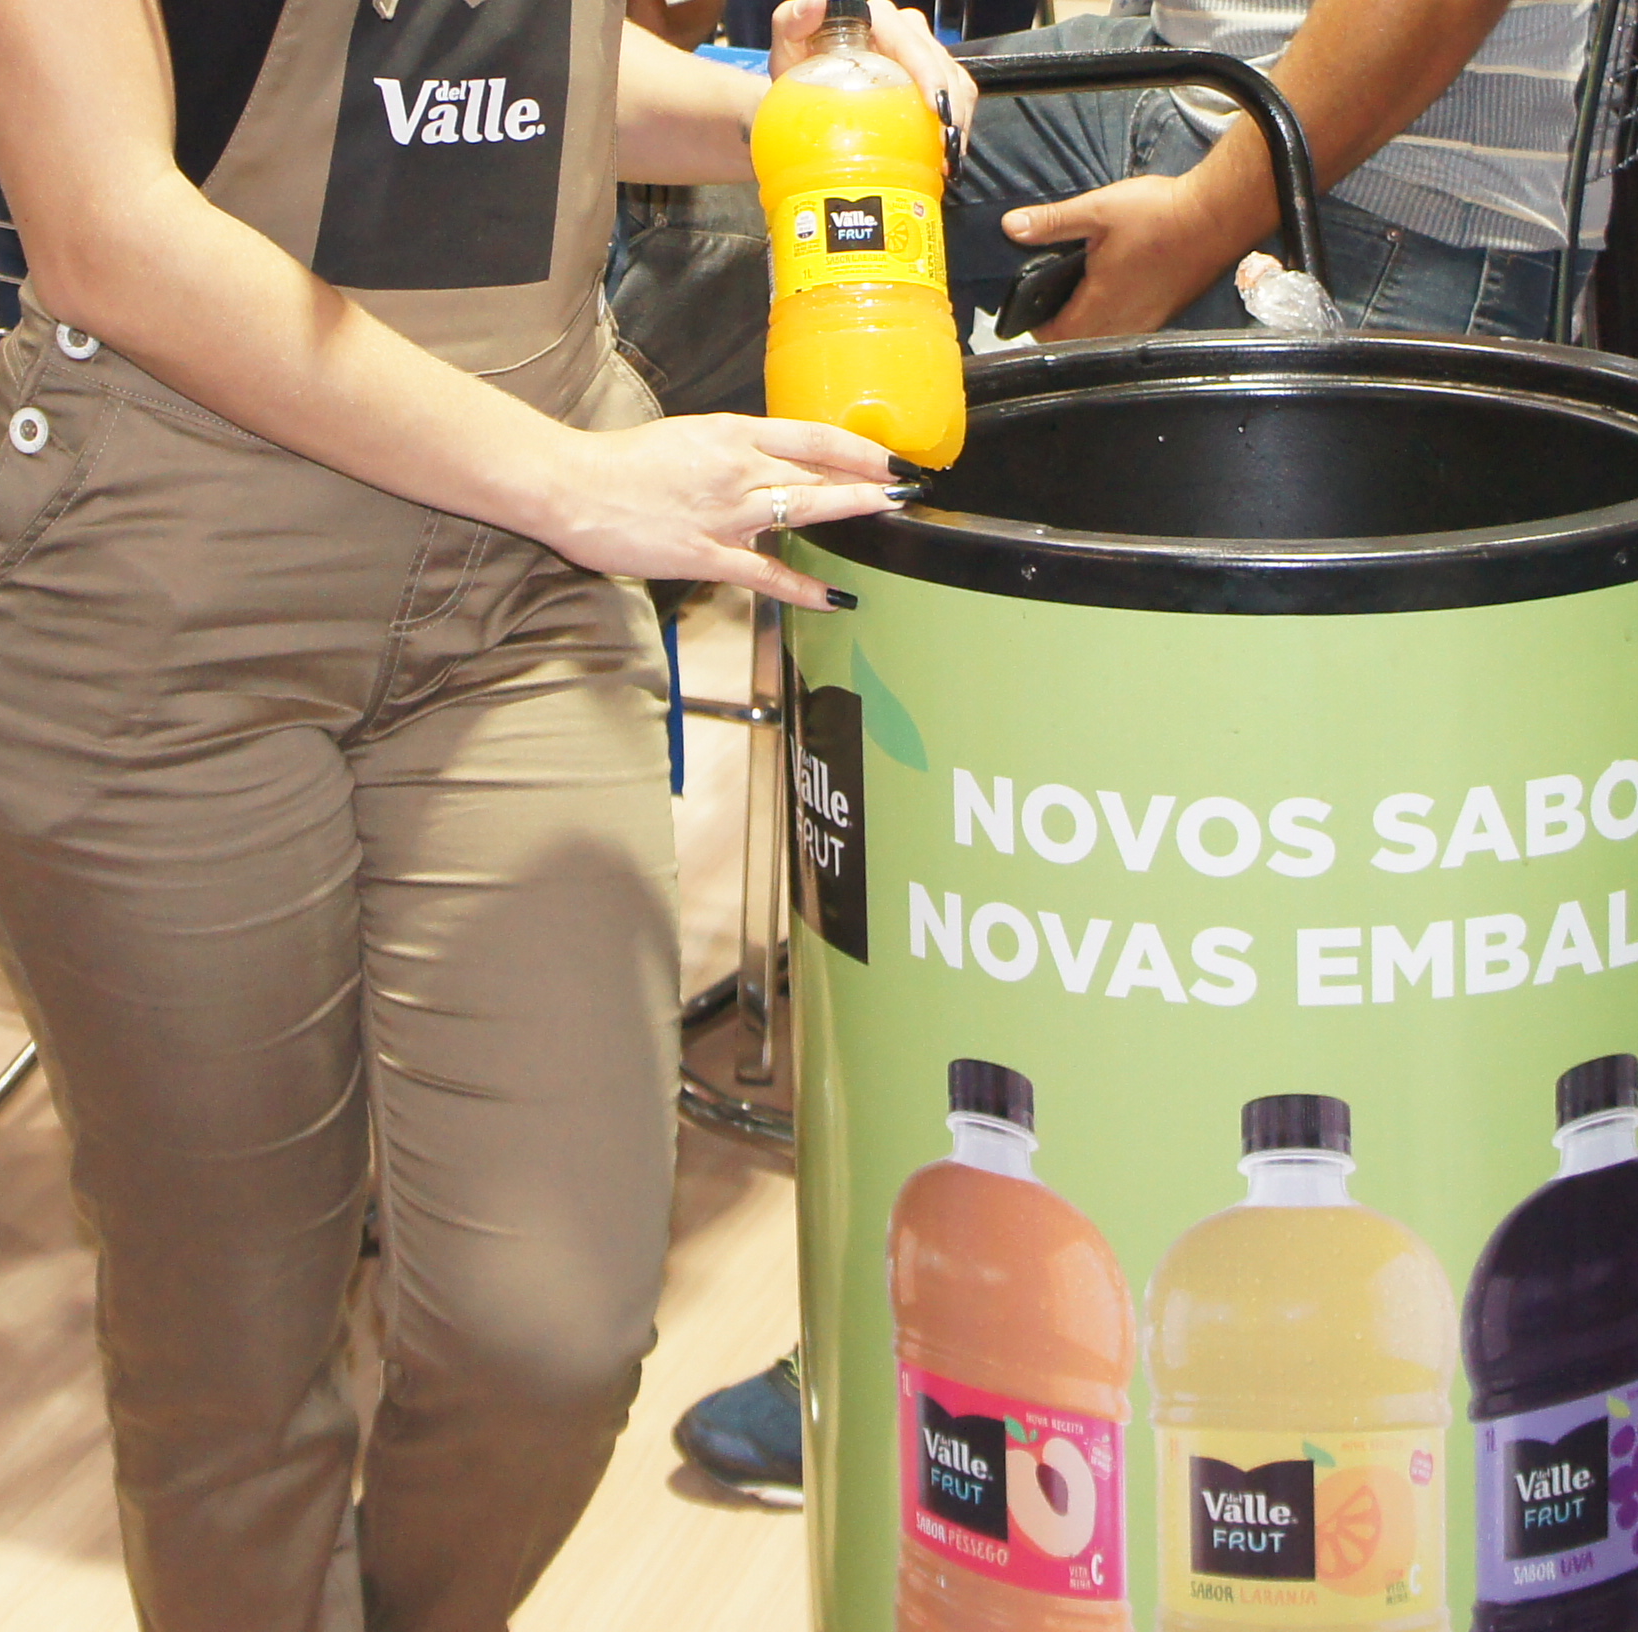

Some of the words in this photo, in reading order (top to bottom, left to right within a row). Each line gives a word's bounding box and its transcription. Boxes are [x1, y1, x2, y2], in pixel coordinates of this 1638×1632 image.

[435, 80, 467, 102] del
[838, 229, 874, 241] FRUT
[953, 767, 1336, 878] NOVOS
[796, 806, 845, 877] FRUT
[908, 881, 1258, 1005] NOVAS
[922, 1426, 990, 1481] Valle
[930, 1467, 983, 1505] FRUT
[1515, 1463, 1592, 1504] Valle
[1202, 1490, 1292, 1526] Valle
[1524, 1497, 1585, 1530] FRUT
[916, 1510, 946, 1545] SABOR
[1213, 1528, 1286, 1554] FRUT
[1512, 1560, 1557, 1587] SABOR
[1190, 1580, 1234, 1604] SABOR
[1239, 1582, 1319, 1607] LARANJA
